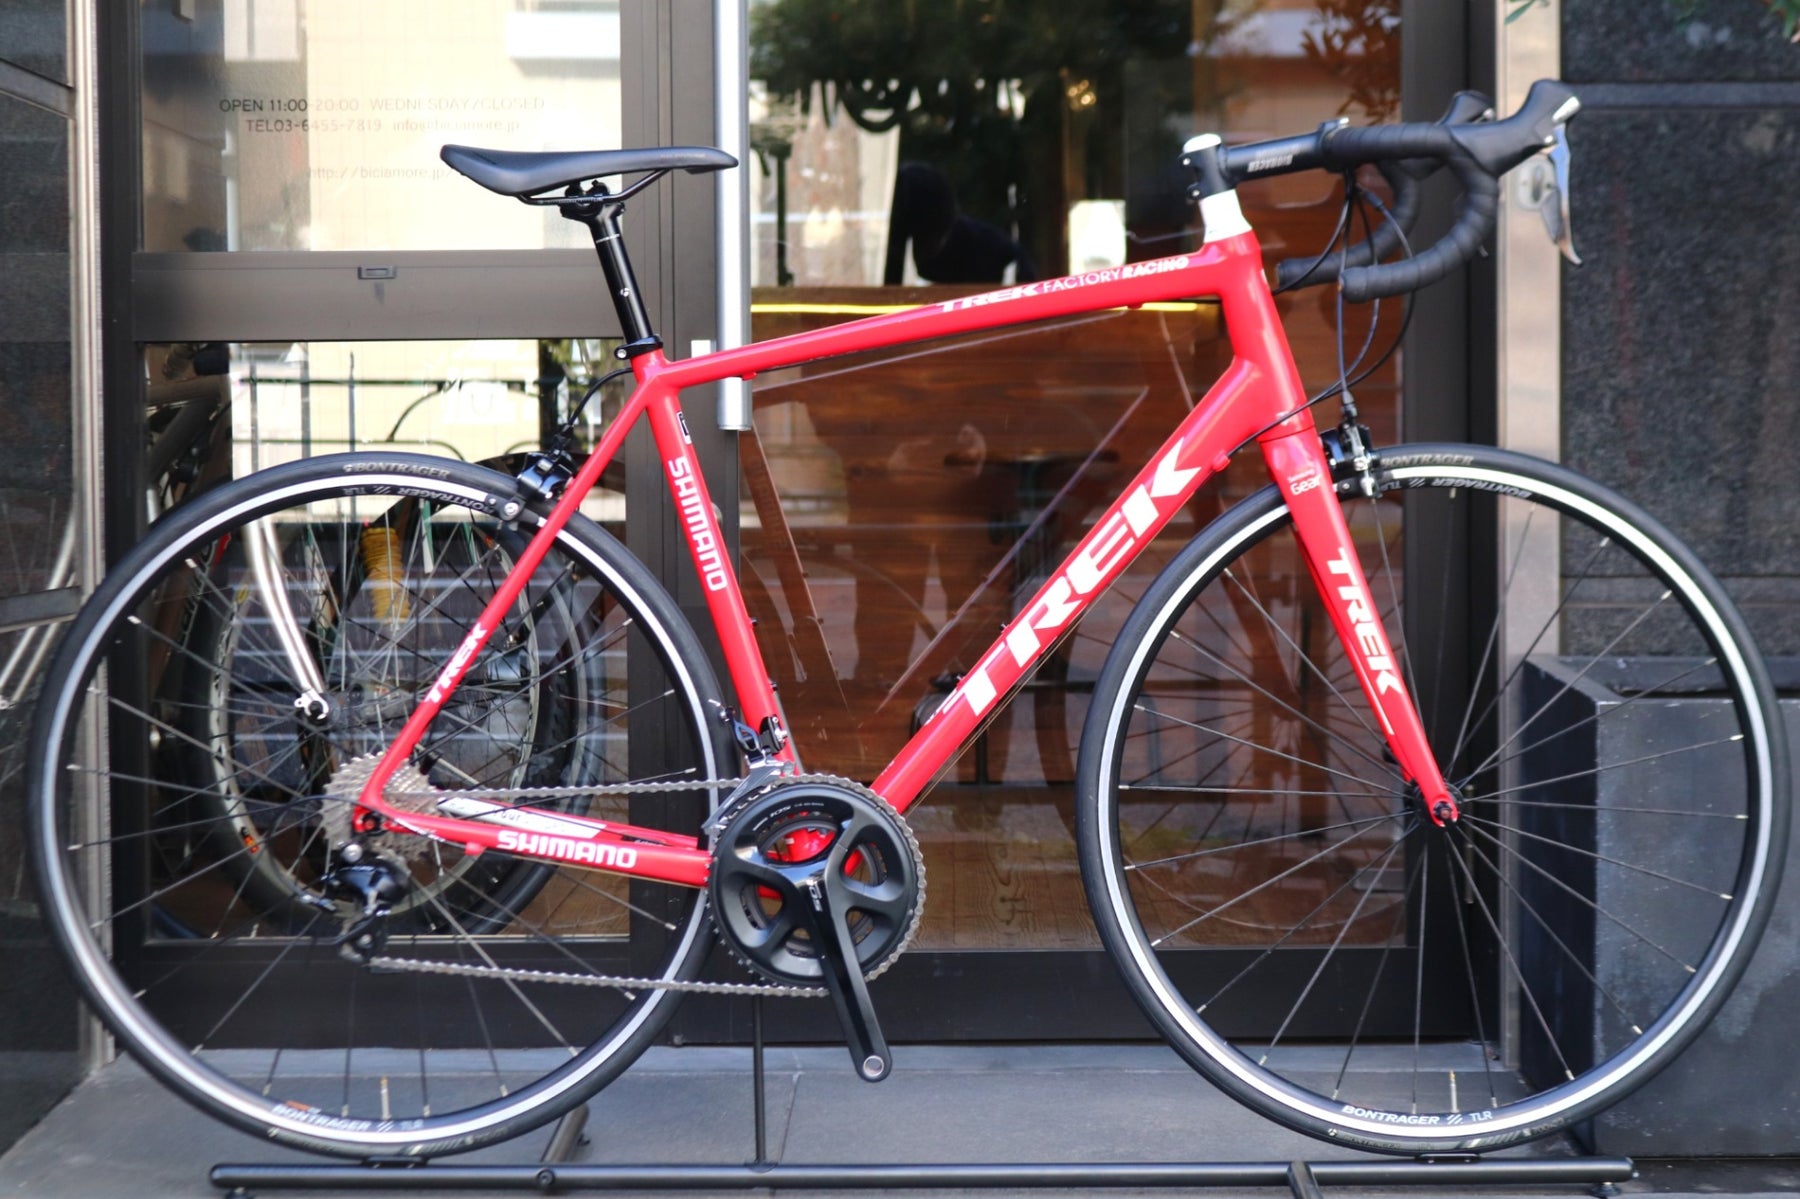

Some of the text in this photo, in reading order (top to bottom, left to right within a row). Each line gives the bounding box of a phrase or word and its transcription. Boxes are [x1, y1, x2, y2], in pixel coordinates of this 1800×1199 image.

[219, 99, 263, 112] OPEN
[937, 256, 1189, 312] TREK FACTORY RACING
[356, 462, 450, 480] BONTRAGER
[1380, 454, 1474, 467] BONTRAGER
[1290, 475, 1321, 496] Gear
[1431, 478, 1532, 499] BONTRAGER
[668, 456, 728, 591] SHIMANO
[942, 436, 1202, 717] TREK
[1327, 547, 1404, 695] TREK
[424, 621, 488, 704] TREK
[496, 829, 637, 869] SHIMANO
[272, 1104, 373, 1131] BONTRAGER
[1341, 1104, 1493, 1126] BONTRAGER TLR
